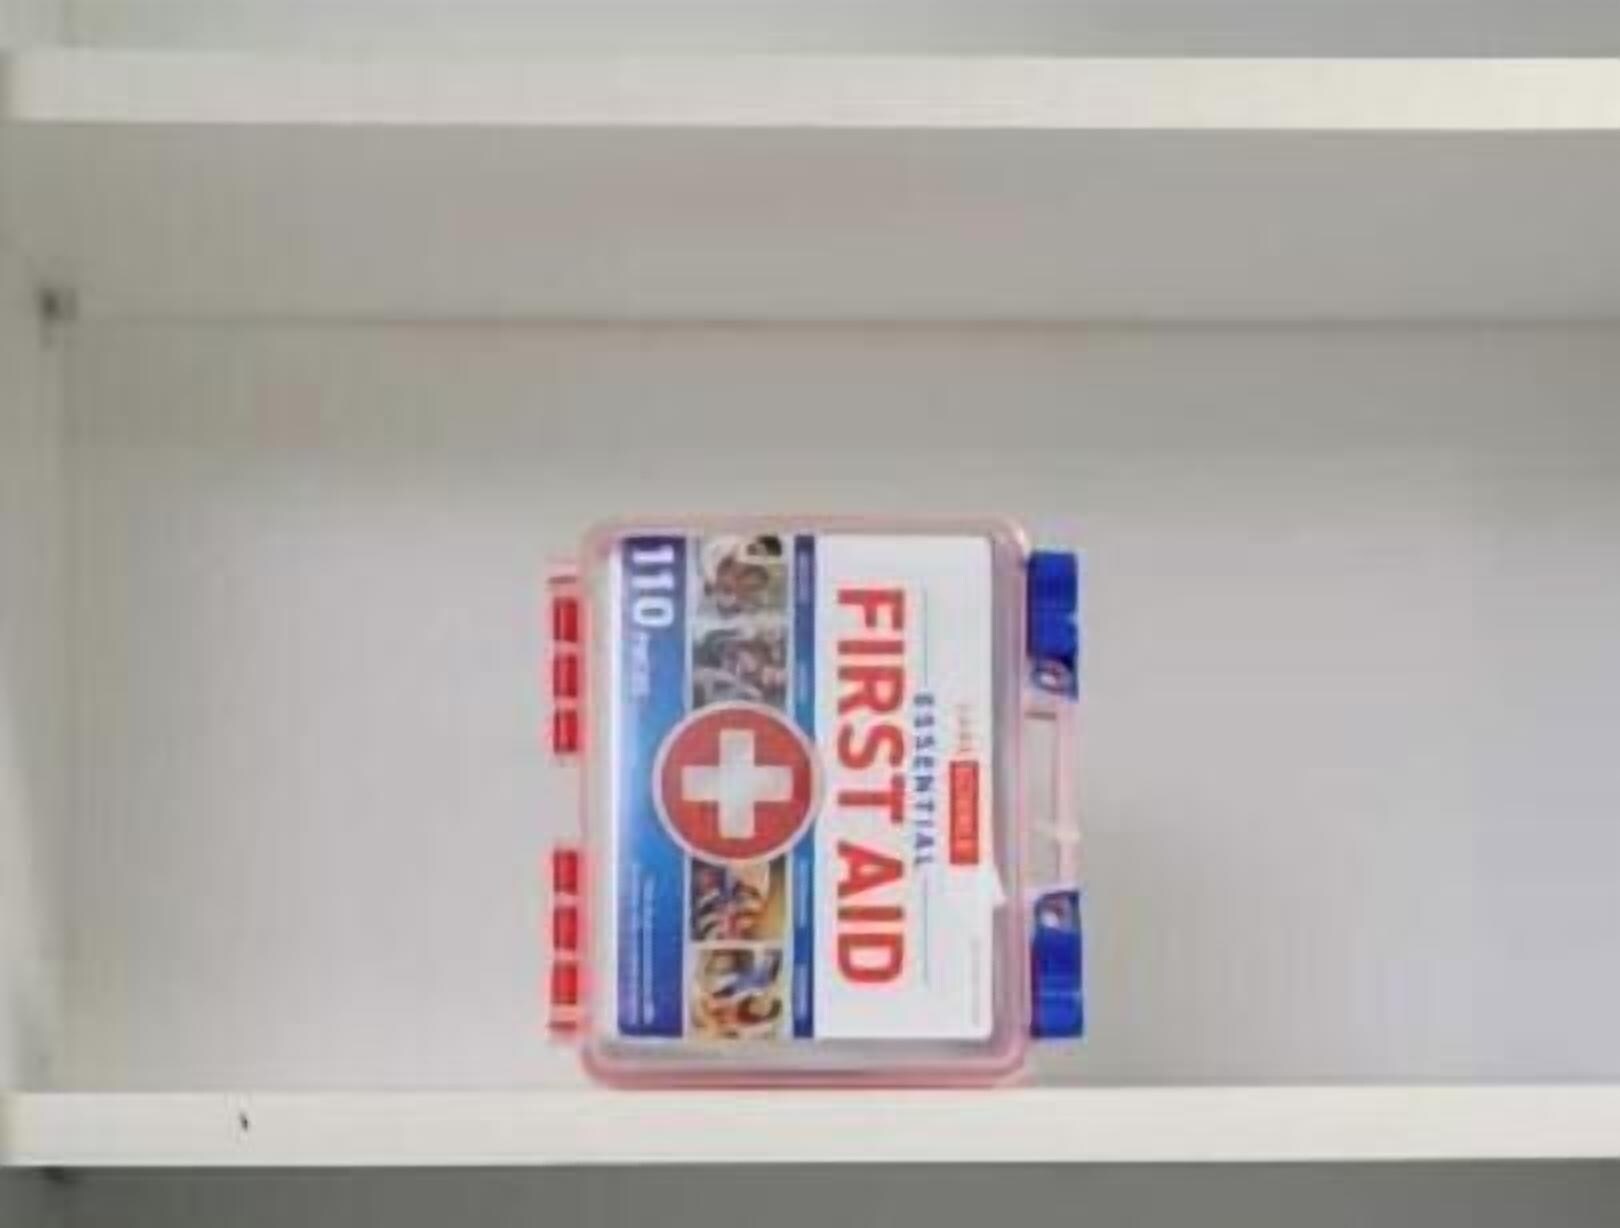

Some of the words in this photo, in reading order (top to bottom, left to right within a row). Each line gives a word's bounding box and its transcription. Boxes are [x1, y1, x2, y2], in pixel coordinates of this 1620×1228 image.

[631, 546, 675, 627] 110
[837, 588, 906, 824] FIRST
[914, 693, 936, 868] ESSENTIAL
[837, 842, 906, 984] AID
